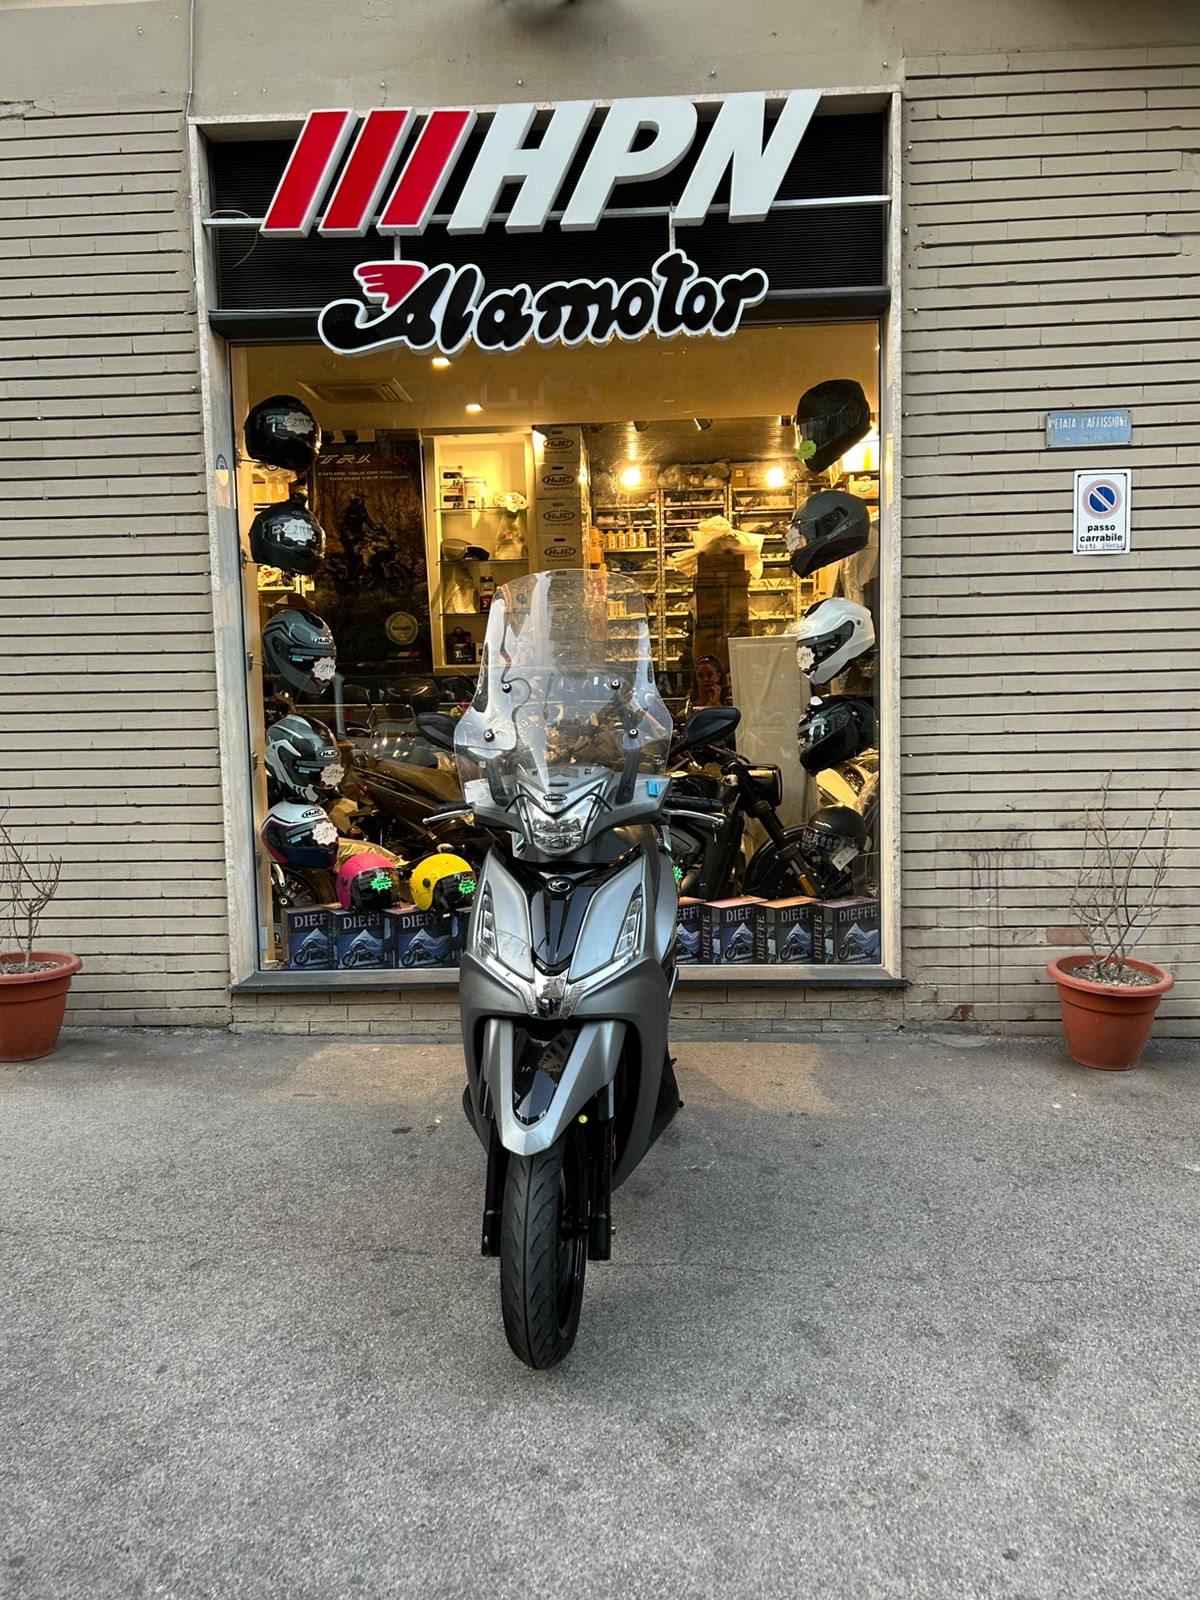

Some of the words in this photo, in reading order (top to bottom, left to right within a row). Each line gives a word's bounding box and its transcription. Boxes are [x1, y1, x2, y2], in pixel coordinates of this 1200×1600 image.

[447, 89, 822, 234] HPN
[319, 249, 769, 356] Alamotor
[319, 454, 371, 465] TRK
[1087, 524, 1116, 533] passo
[1079, 533, 1123, 542] carrabile
[294, 913, 327, 928] DIEF
[726, 907, 752, 922] DIEF
[840, 905, 878, 922] DIEFFE
